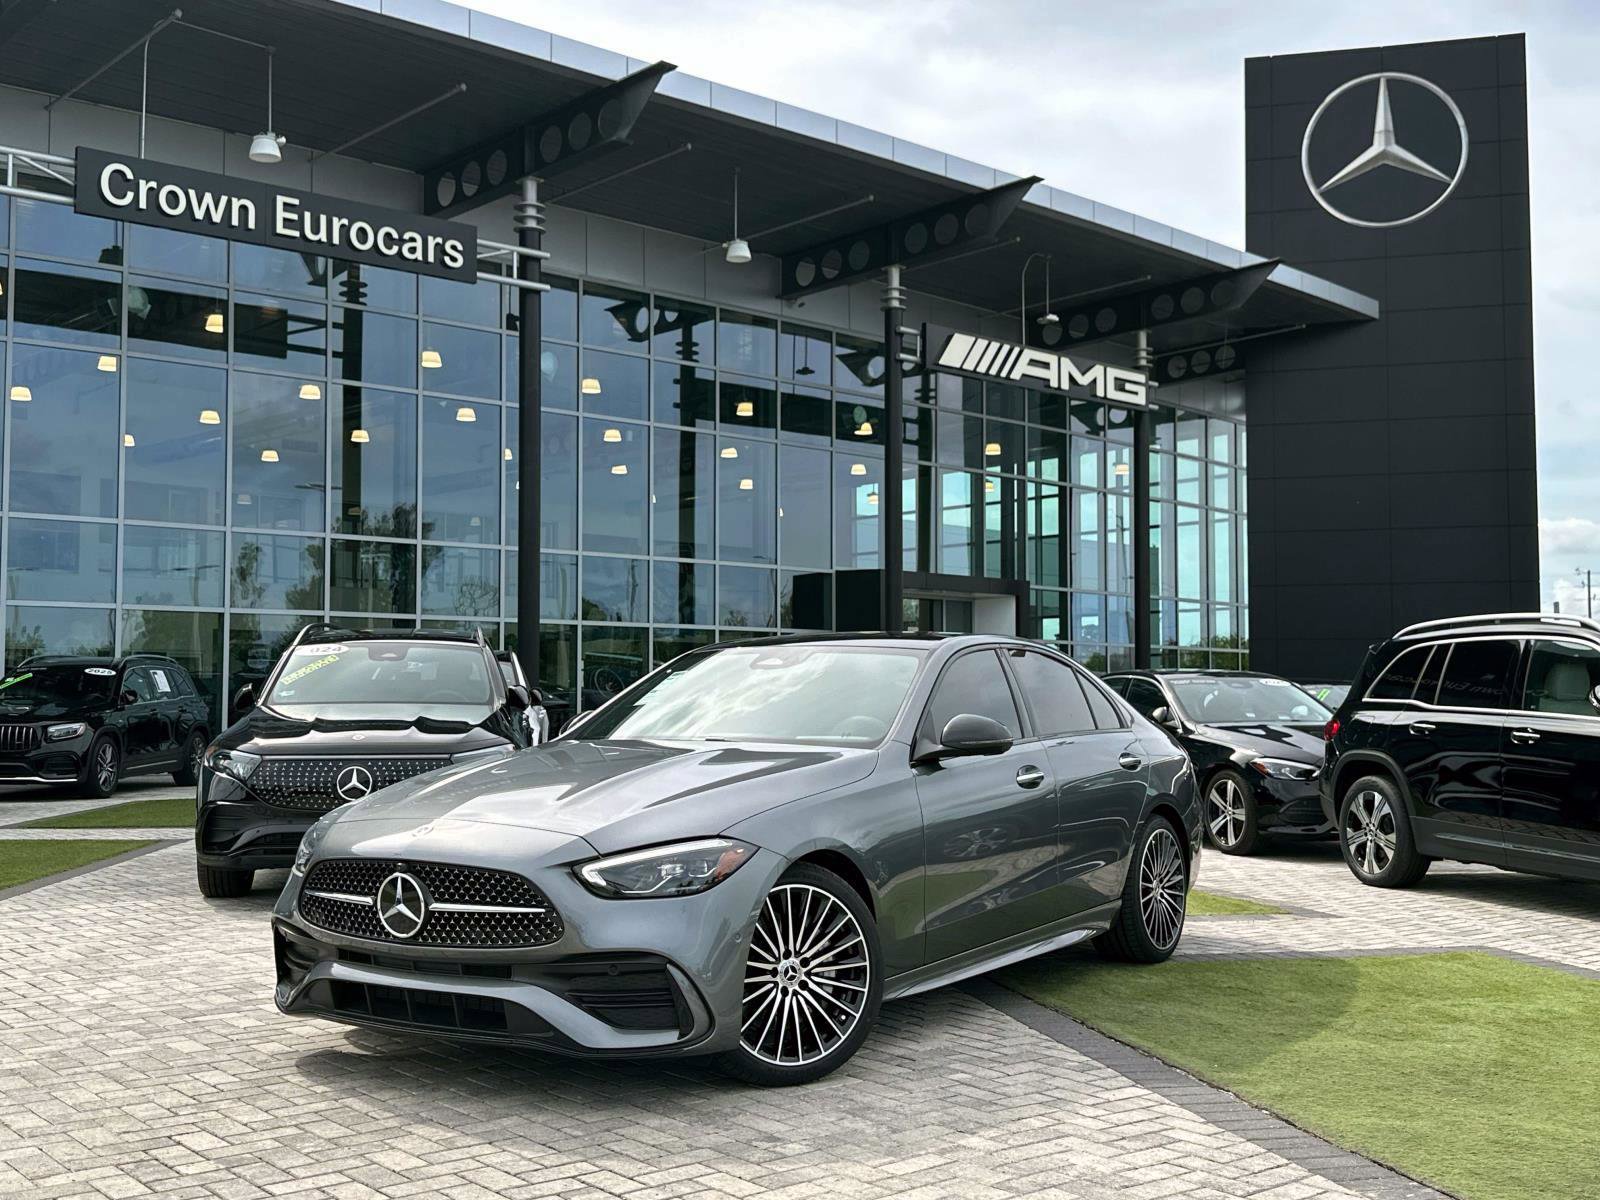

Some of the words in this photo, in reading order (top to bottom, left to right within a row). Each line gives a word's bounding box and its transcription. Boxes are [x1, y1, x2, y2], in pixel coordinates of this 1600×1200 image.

[100, 162, 256, 230] Crown
[276, 194, 464, 268] Eurocars
[1010, 348, 1147, 406] AMG
